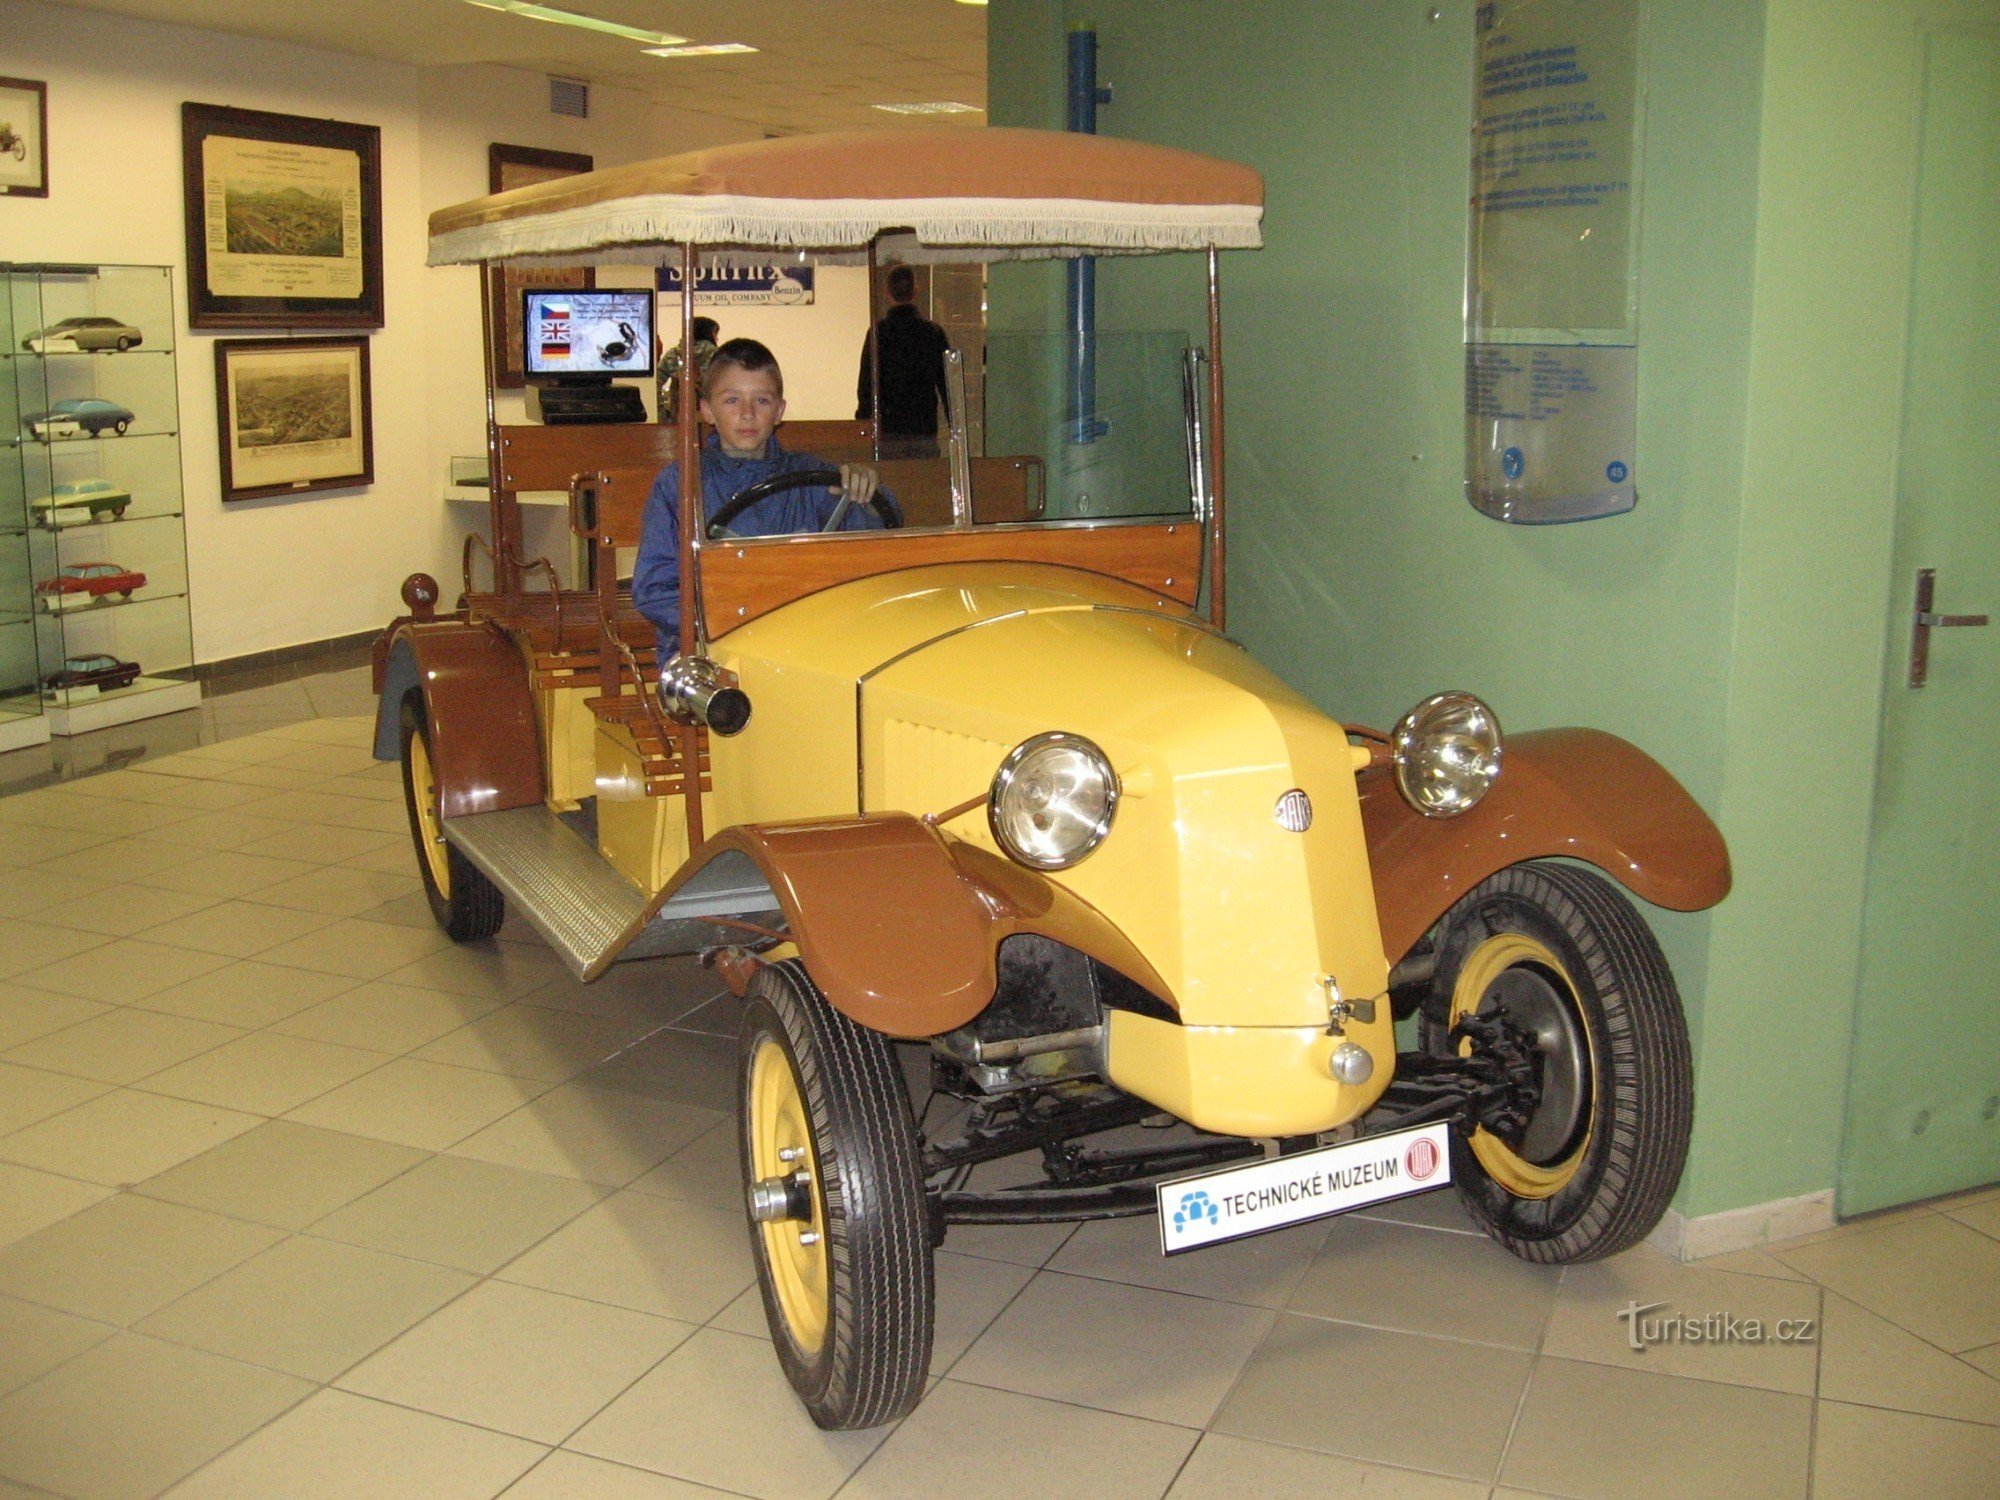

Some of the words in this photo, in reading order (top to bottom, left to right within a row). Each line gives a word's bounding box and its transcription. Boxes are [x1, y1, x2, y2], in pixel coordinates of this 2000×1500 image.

[714, 293, 728, 302] OIL
[732, 293, 772, 301] COMPANY
[1223, 1171, 1323, 1217] TECHNICKÉ
[1328, 1157, 1398, 1193] MUZEUM
